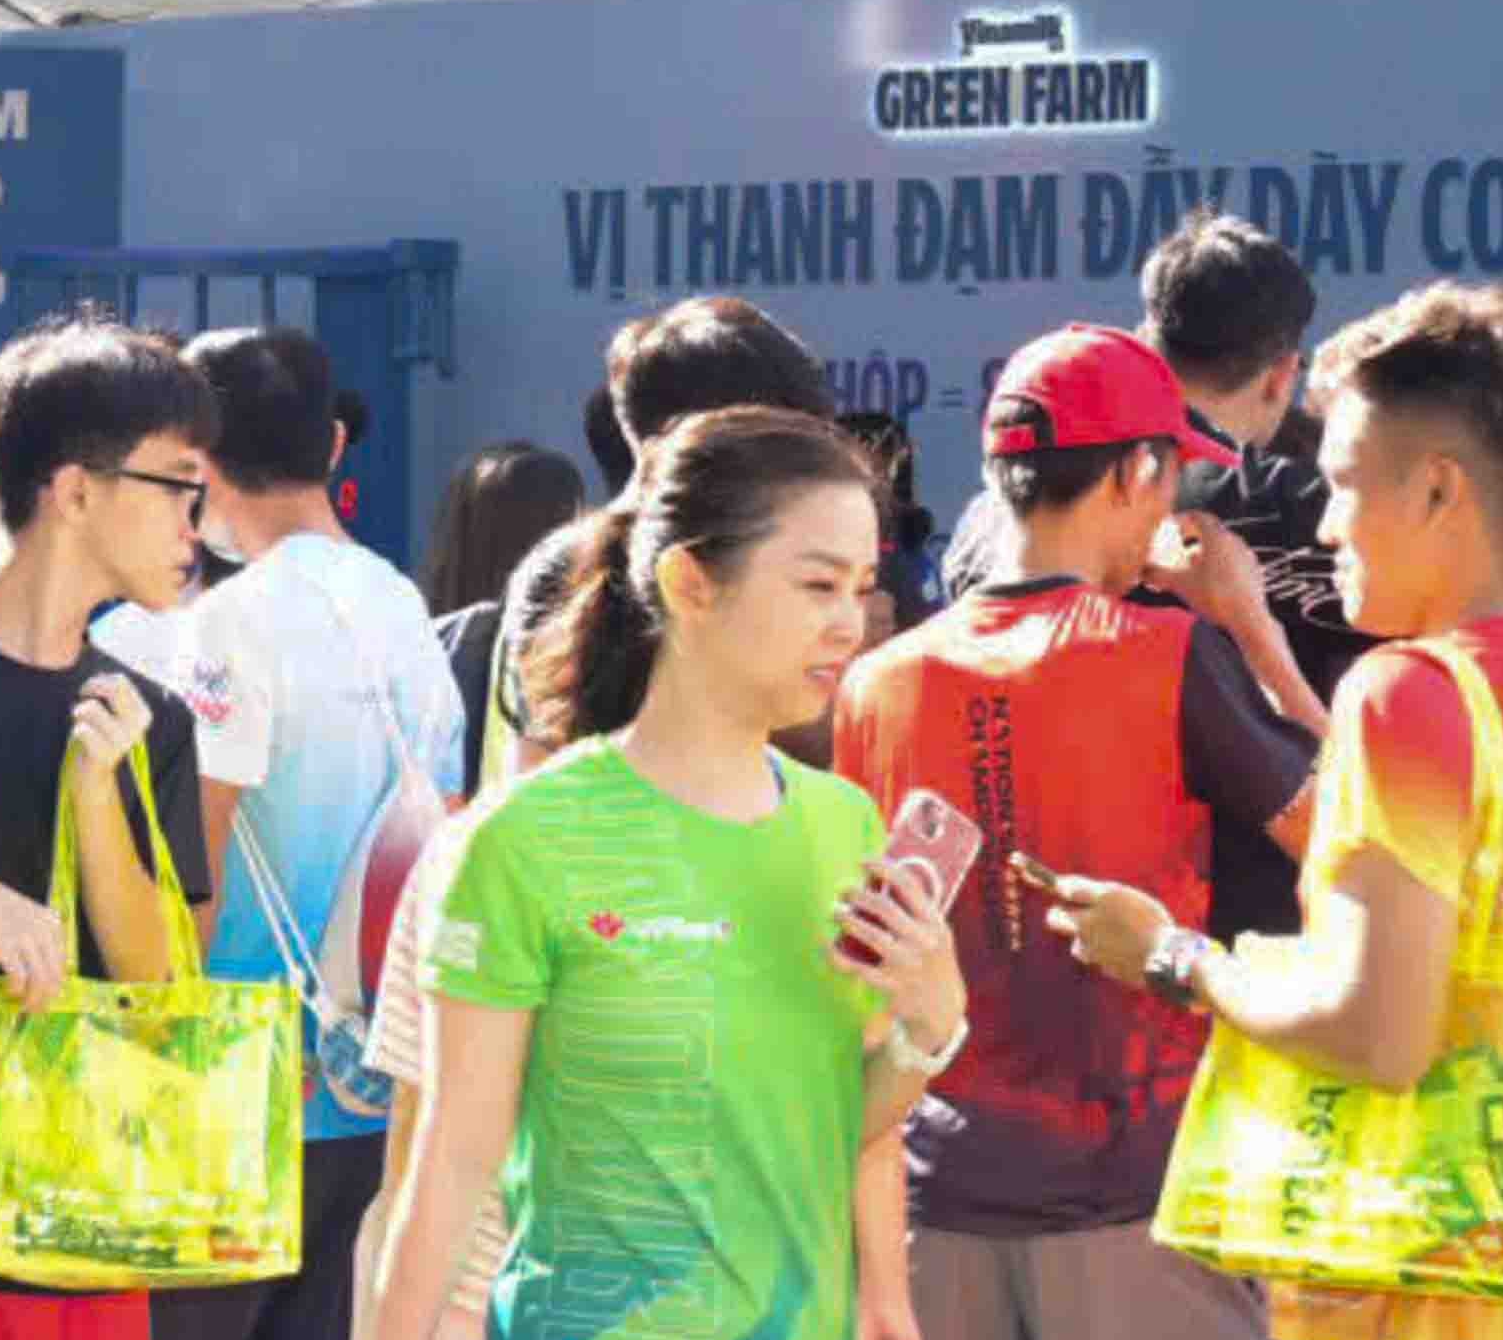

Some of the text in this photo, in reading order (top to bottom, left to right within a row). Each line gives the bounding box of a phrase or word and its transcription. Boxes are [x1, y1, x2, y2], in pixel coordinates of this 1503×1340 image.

[876, 59, 1148, 129] GREEN FARM
[564, 188, 626, 300] VỊ
[646, 179, 874, 287] THANH
[893, 173, 1060, 296] ĐẠM
[1249, 150, 1401, 274] DÀY
